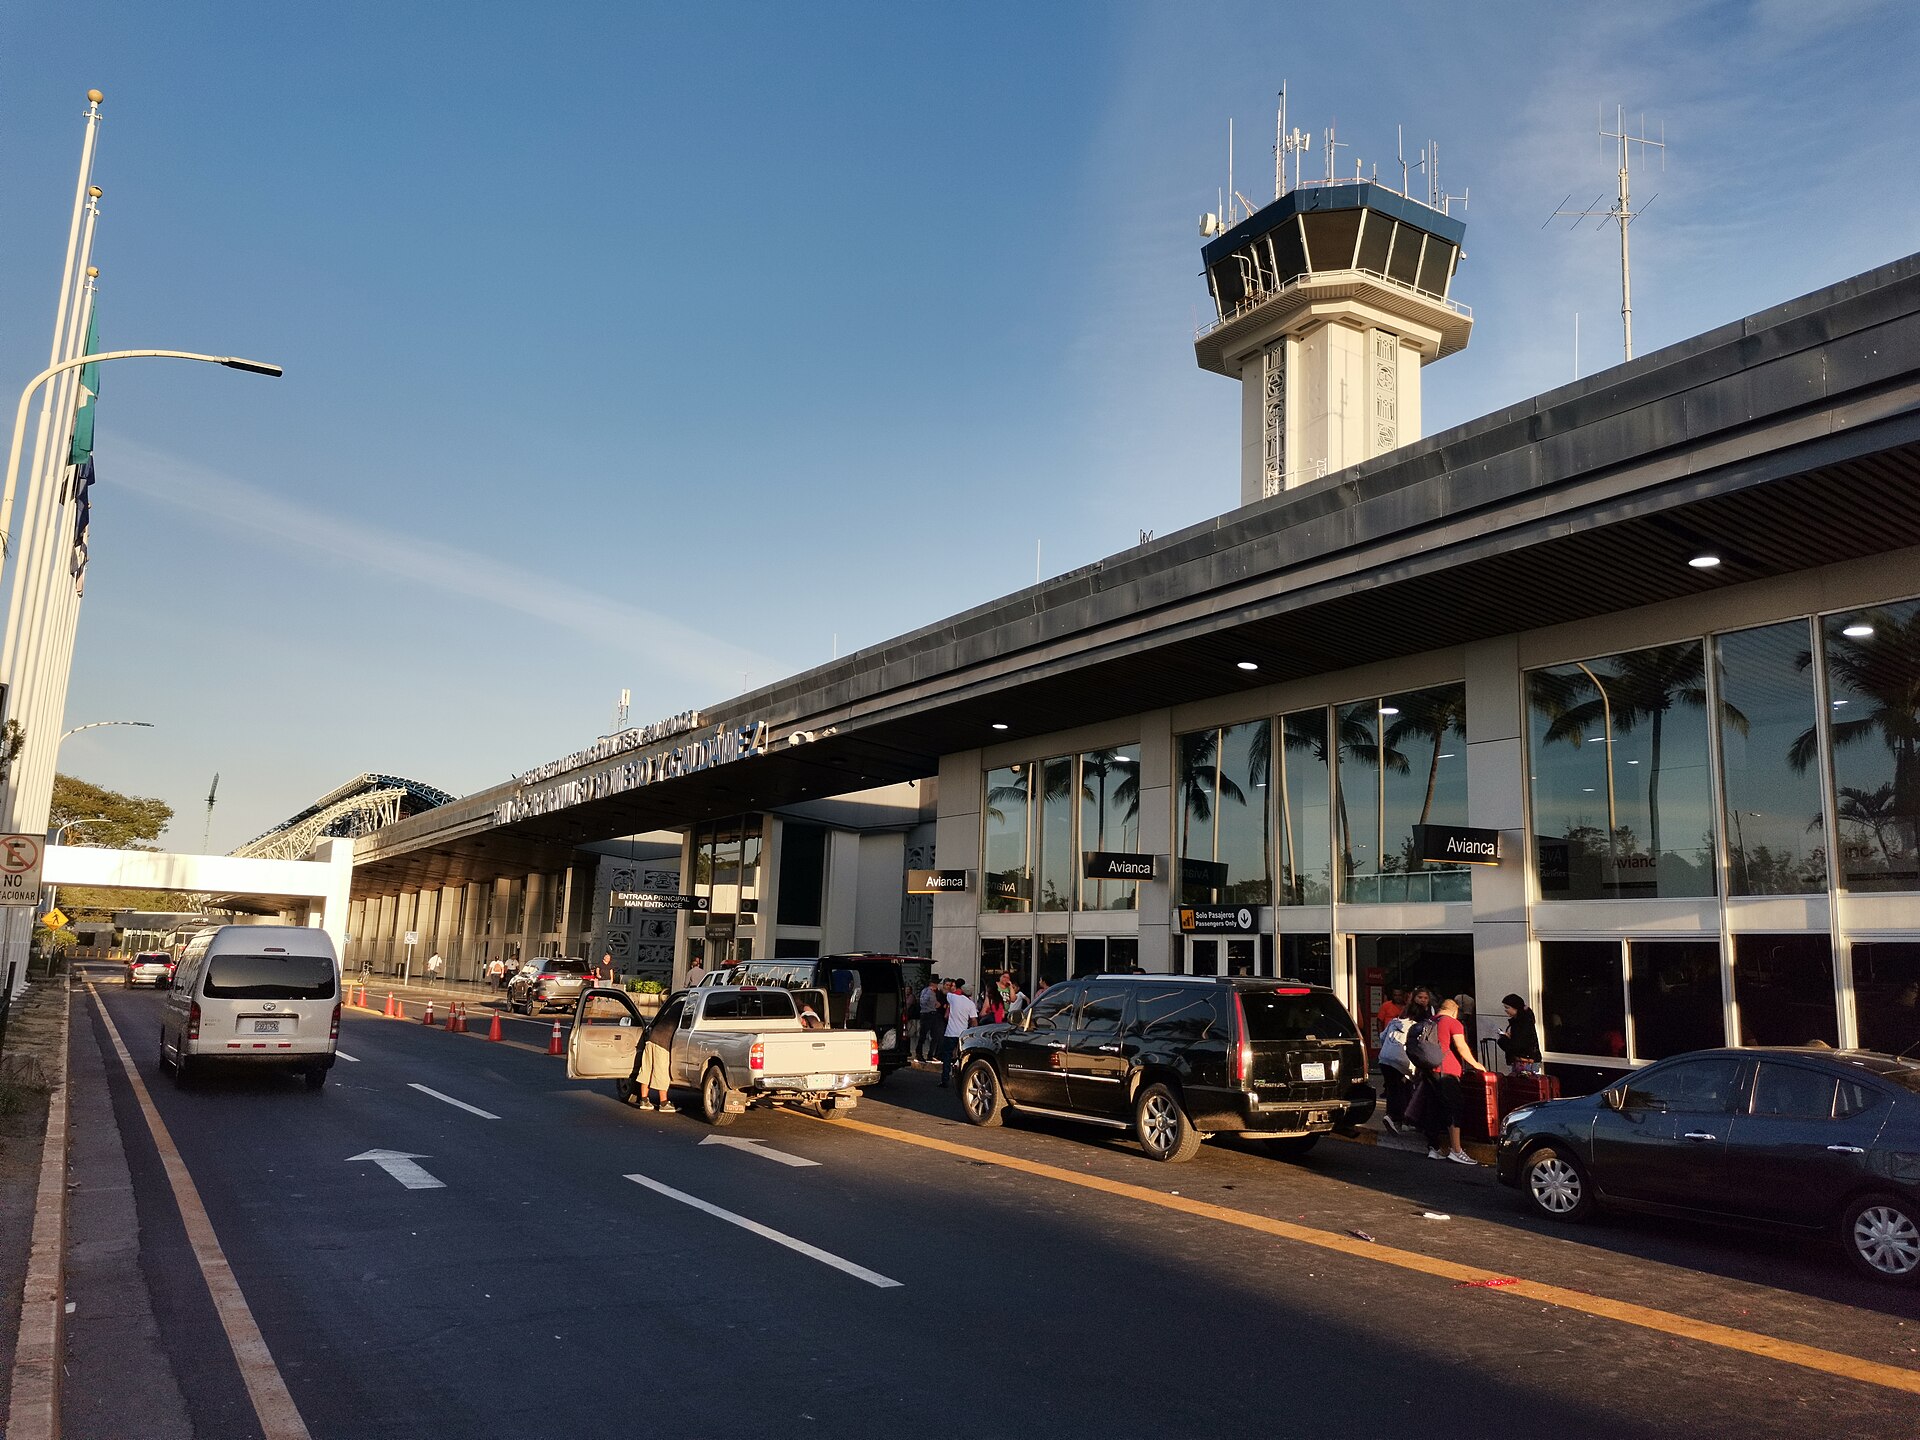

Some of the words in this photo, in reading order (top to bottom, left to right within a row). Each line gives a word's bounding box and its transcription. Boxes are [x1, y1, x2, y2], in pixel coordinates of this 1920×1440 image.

[596, 757, 653, 799] ROMERO
[655, 751, 669, 782] Y
[669, 721, 765, 778] GALDÁMEZ
[1447, 836, 1495, 855] Avianca
[1108, 860, 1150, 874] Avianca
[4, 874, 23, 888] NO
[926, 876, 963, 887] Avianca
[618, 893, 653, 901] ENTRADA
[653, 894, 690, 903] PRINCIPAL
[644, 900, 683, 909] ENTRANCE
[1195, 911, 1208, 919] Solo
[1208, 911, 1235, 920] Pasajeros
[1195, 920, 1224, 928] Passengers
[1224, 920, 1238, 928] Only
